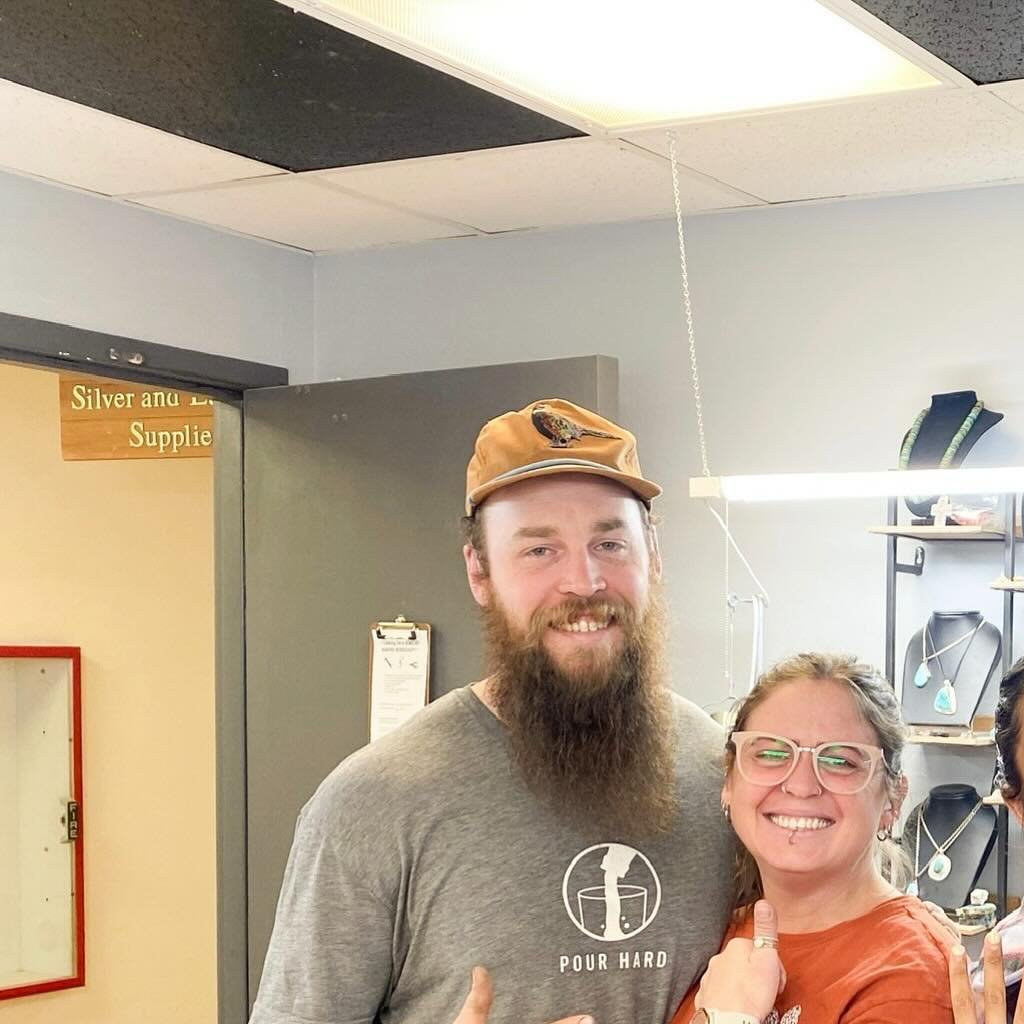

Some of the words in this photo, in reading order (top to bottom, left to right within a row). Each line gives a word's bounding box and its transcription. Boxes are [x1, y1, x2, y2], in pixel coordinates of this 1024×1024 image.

[71, 384, 135, 410] Silver
[128, 421, 213, 454] Supplie
[560, 953, 608, 973] POUR
[619, 951, 667, 969] HARD
